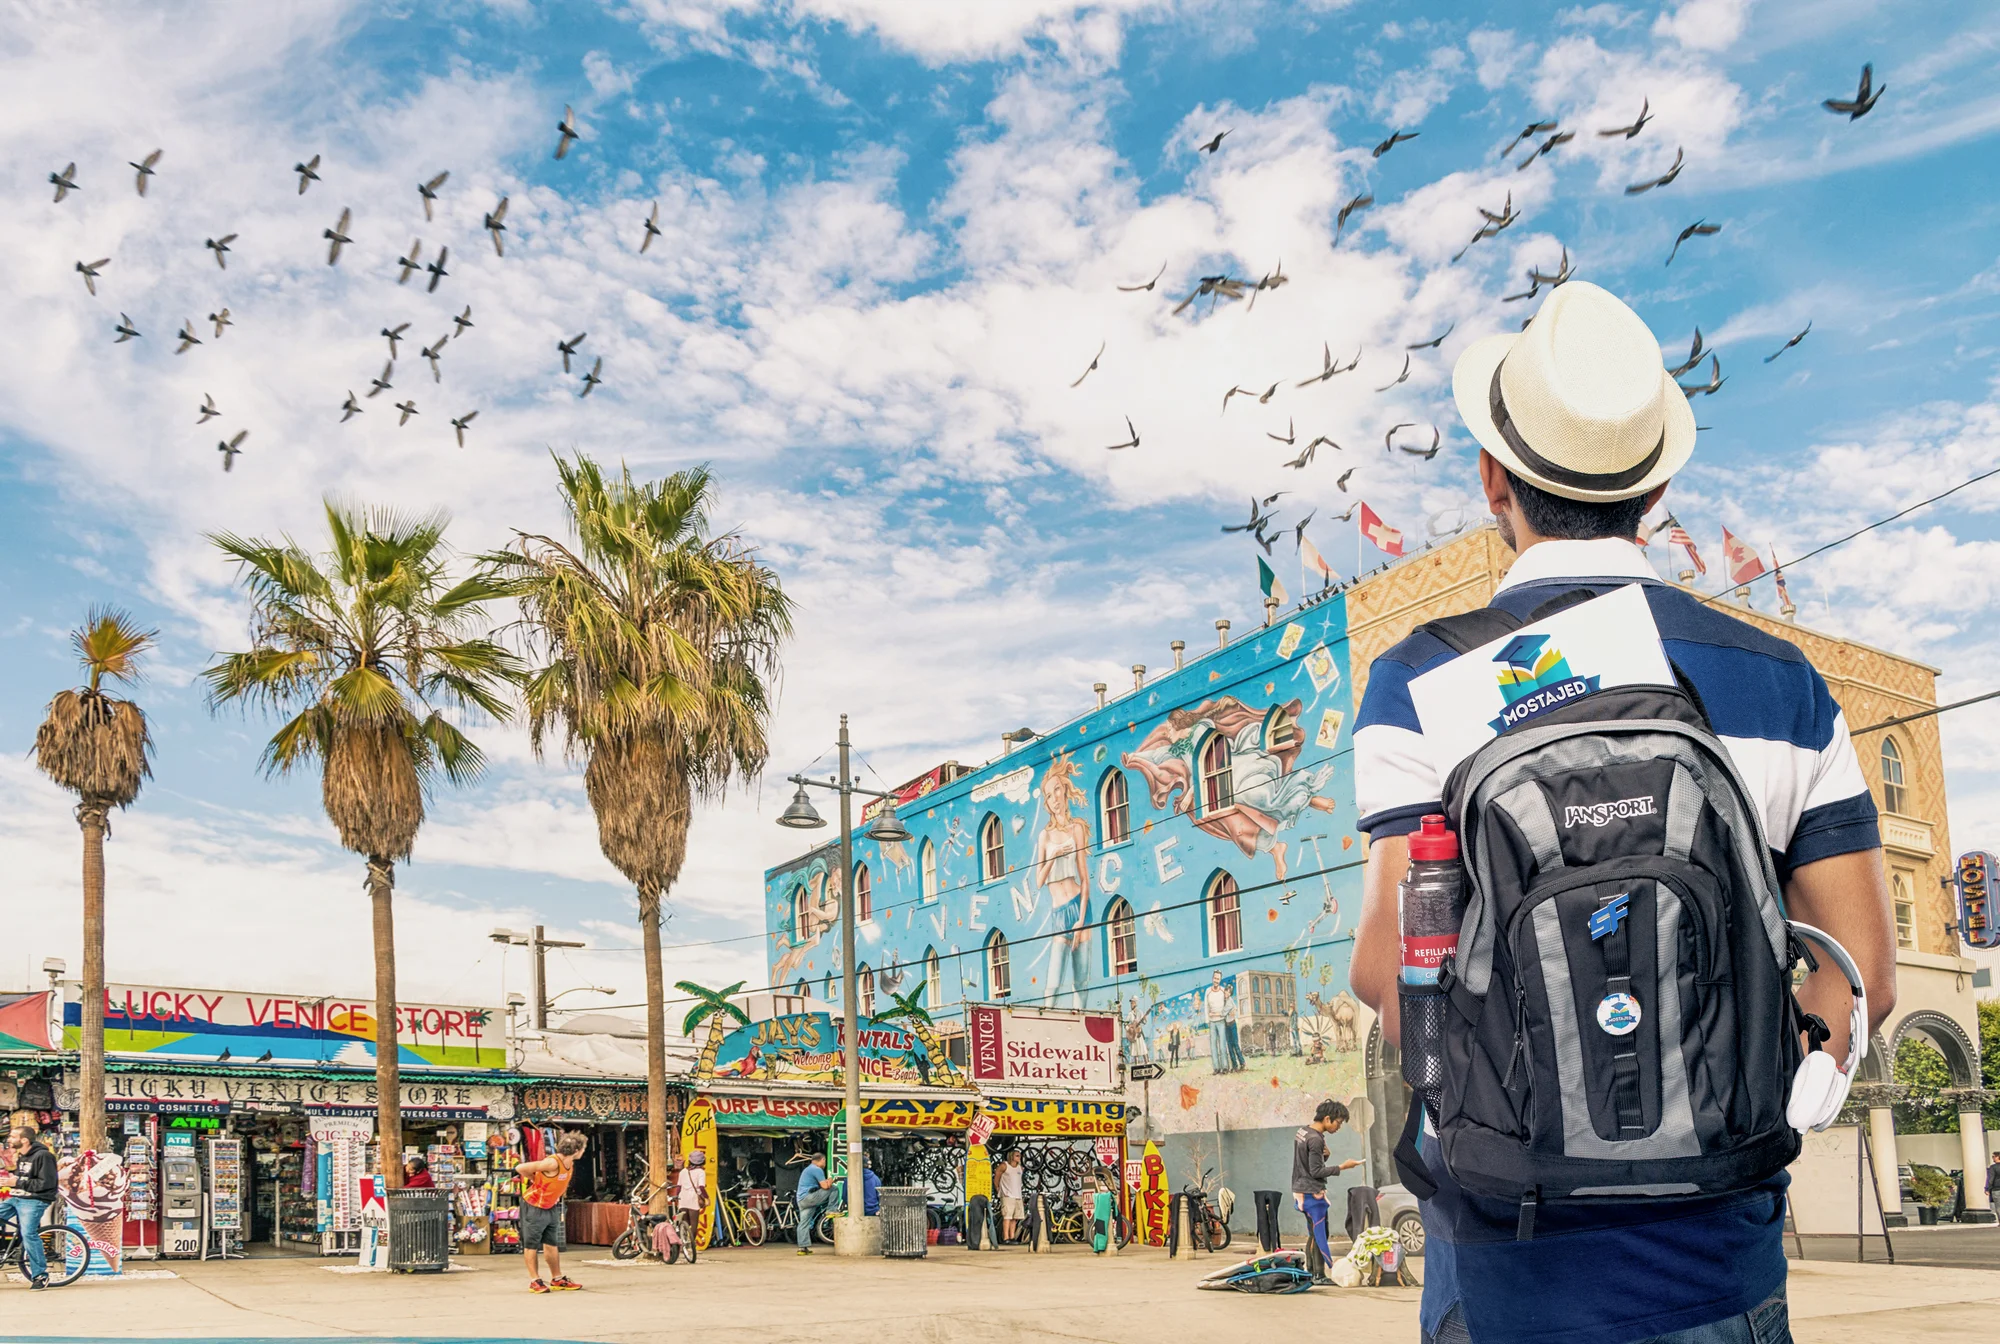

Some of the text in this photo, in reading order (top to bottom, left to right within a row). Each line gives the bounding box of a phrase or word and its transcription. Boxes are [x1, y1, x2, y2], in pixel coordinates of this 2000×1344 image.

[1503, 681, 1587, 727] MOSTAJED
[1565, 796, 1654, 828] JANSPORT
[1961, 854, 1987, 944] HOSTEL
[1590, 892, 1630, 941] SF
[1415, 947, 1457, 957] REFILLABL
[104, 988, 223, 1024] LUCKY
[246, 998, 367, 1033] VENICE
[752, 1014, 821, 1048] JAYS
[837, 1023, 915, 1050] RNTALS
[979, 1011, 997, 1074] VENICE
[1007, 1041, 1105, 1062] Sidewalk
[793, 1051, 833, 1066] Welcome
[838, 1050, 919, 1081] VNICE Beach
[1009, 1061, 1088, 1081] Market
[104, 1077, 472, 1106] UCKY VENICE SORE
[524, 1089, 587, 1111] GONZO
[159, 1104, 221, 1112] COSMETICS
[258, 1102, 291, 1113] Marlboro
[304, 1108, 378, 1117] MULTI-ADAPTE
[400, 1110, 448, 1118] EVERAGES
[761, 1095, 840, 1118] LESSONS
[985, 1096, 1125, 1119] Surfing
[170, 1117, 219, 1129] ATM
[324, 1120, 359, 1129] PREMIUM
[685, 1109, 713, 1137] Surf
[862, 1112, 971, 1128] entals
[973, 1115, 996, 1132] ATM
[986, 1115, 1123, 1133] Bikes Skates
[167, 1136, 191, 1144] ATM
[314, 1130, 371, 1141] CIGRS
[1097, 1136, 1117, 1148] ATM
[1143, 1154, 1165, 1247] BIKES
[69, 1240, 120, 1258] DRMSTICK
[174, 1239, 198, 1252] 200
